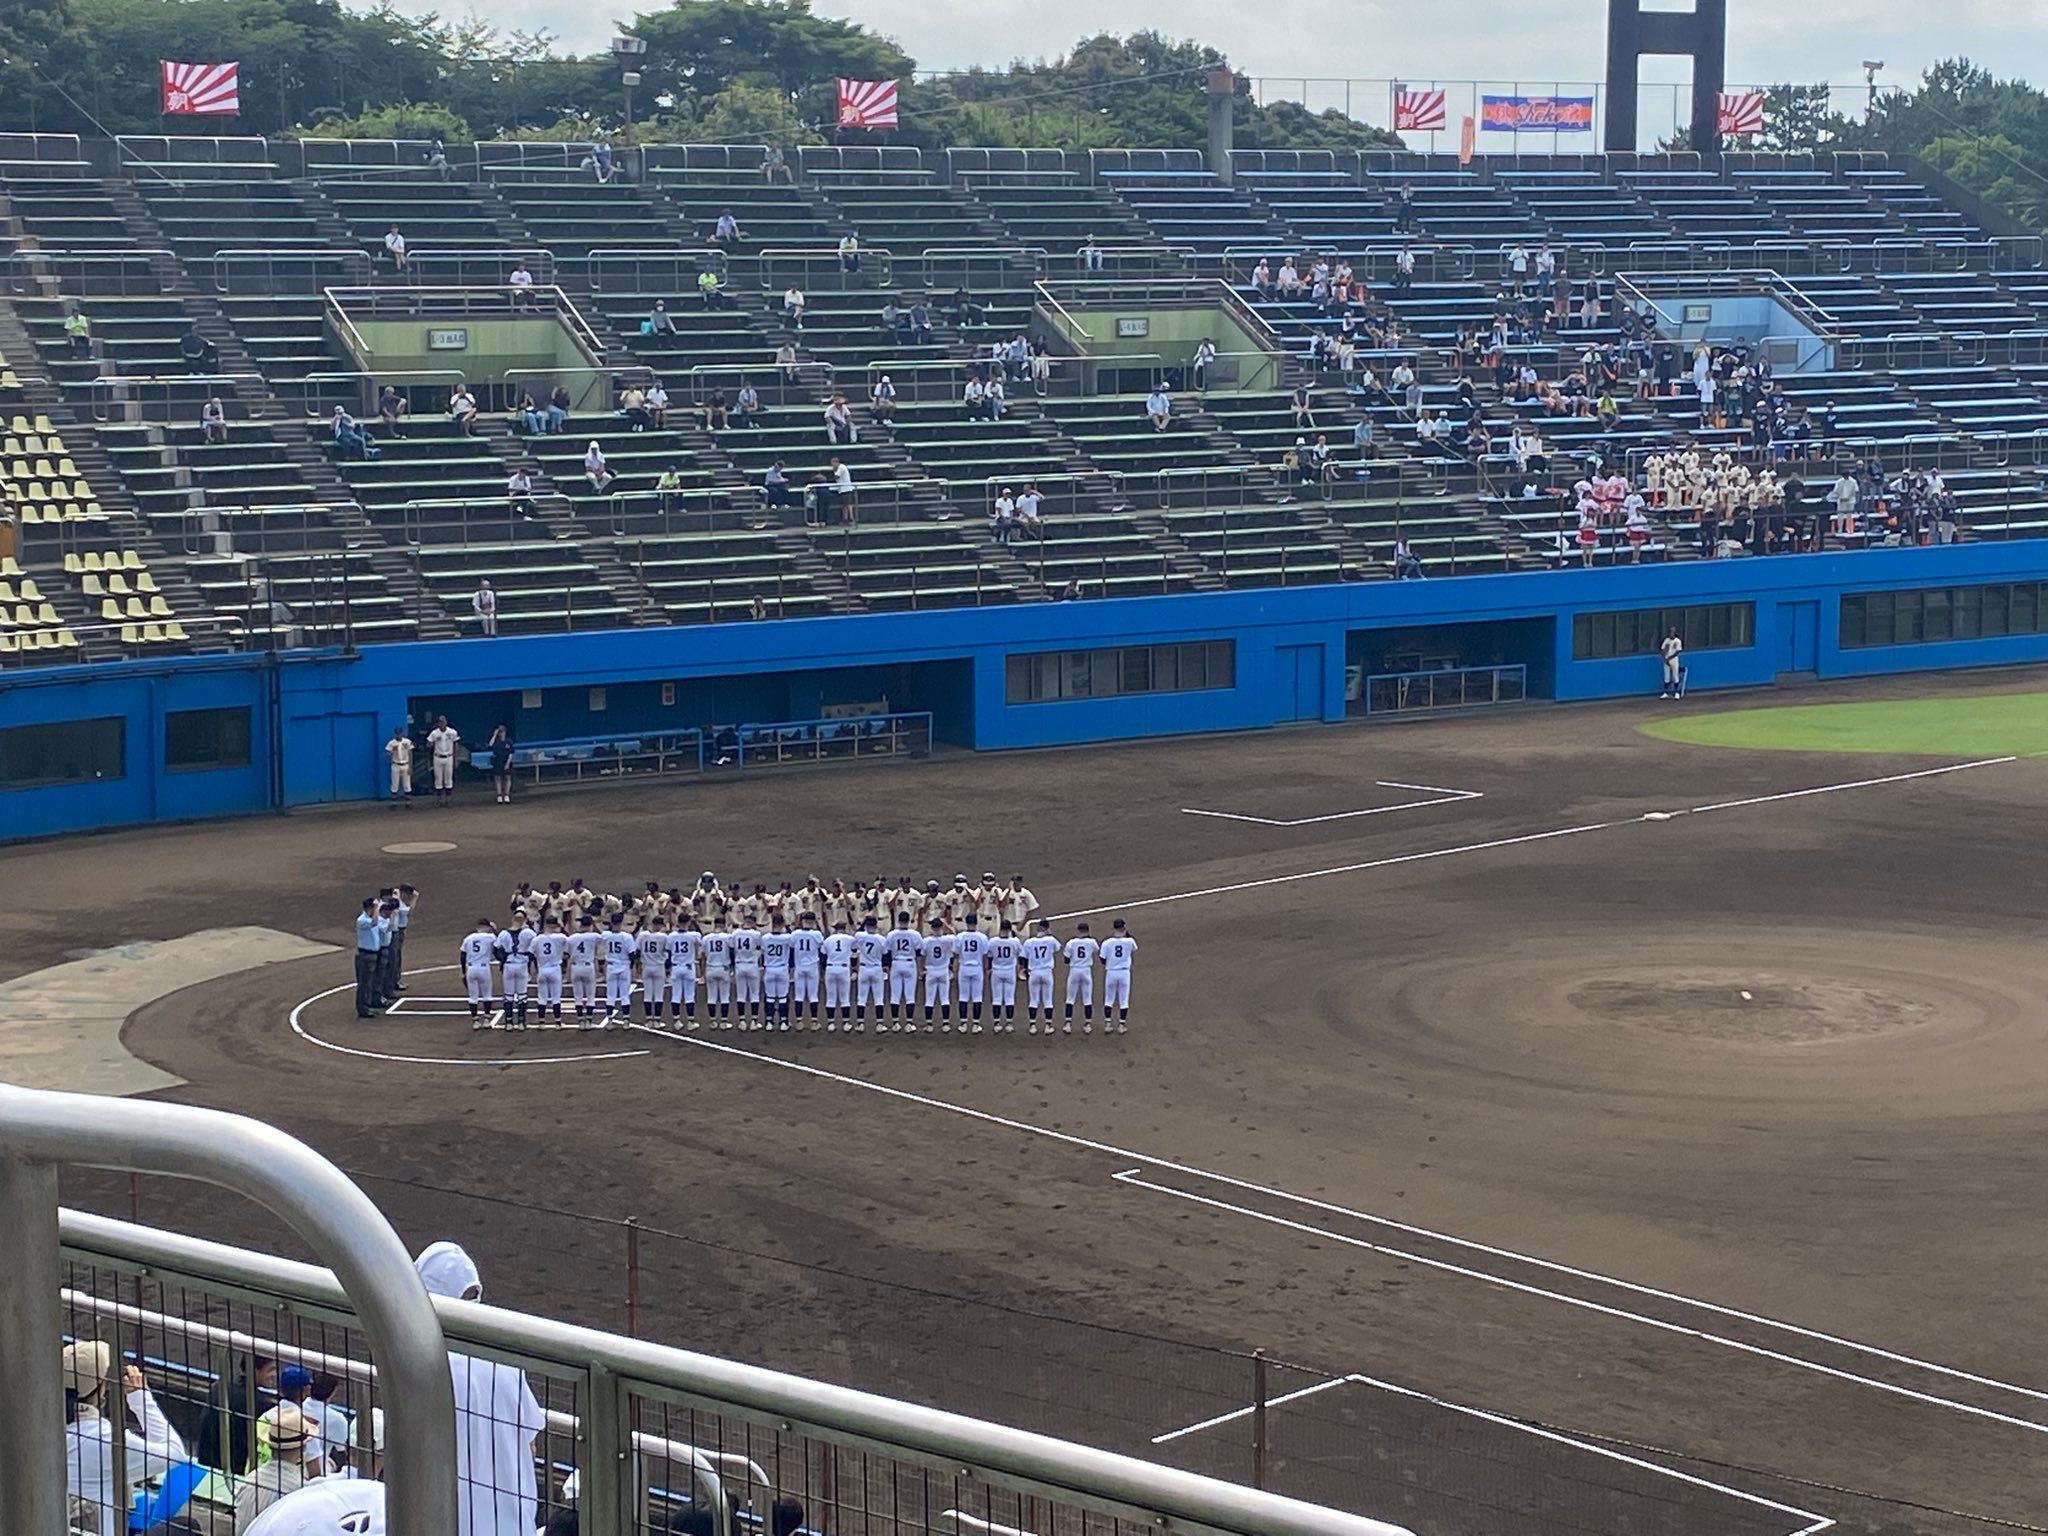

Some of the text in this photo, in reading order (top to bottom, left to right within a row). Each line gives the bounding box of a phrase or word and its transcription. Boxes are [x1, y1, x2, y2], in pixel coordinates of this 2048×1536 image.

[472, 940, 480, 953] 5
[543, 943, 552, 955] 3
[577, 941, 585, 953] 4
[608, 941, 622, 953] 15
[674, 941, 689, 953] 13
[709, 940, 723, 952] 18
[737, 937, 750, 950] 14
[799, 939, 810, 951] 11
[835, 940, 841, 952] 1
[866, 942, 874, 954] 7
[897, 939, 909, 951] 12
[964, 940, 978, 952] 19
[767, 944, 782, 957] 20
[933, 946, 942, 958] 9
[997, 946, 1011, 958] 10
[1034, 946, 1048, 959] 17
[1077, 946, 1086, 958] 6
[1114, 945, 1123, 958] 8
